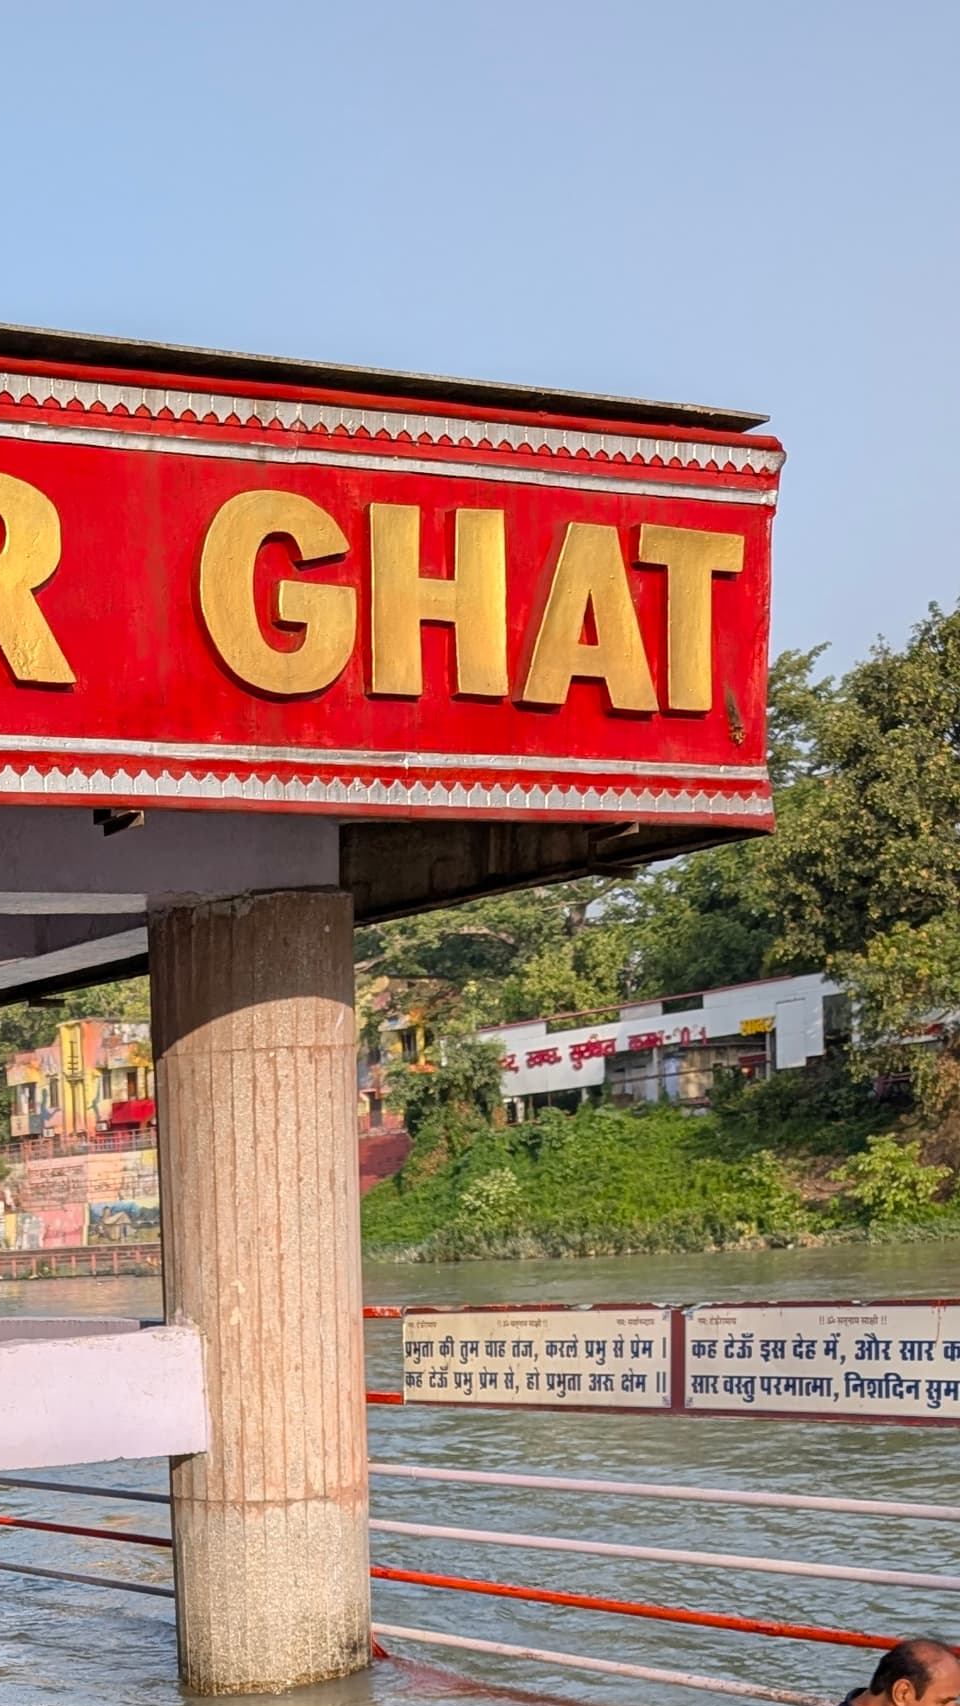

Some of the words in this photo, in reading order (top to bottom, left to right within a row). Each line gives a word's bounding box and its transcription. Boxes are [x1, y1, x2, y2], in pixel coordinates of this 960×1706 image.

[200, 490, 744, 714] GHAT
[405, 1341, 434, 1364] प्रभुता
[439, 1336, 455, 1357] की
[460, 1341, 479, 1364] तुम
[485, 1341, 506, 1357] चाह
[512, 1341, 538, 1361] तज,
[545, 1334, 578, 1358] करले
[585, 1340, 607, 1365] प्रभु
[613, 1334, 624, 1358] से
[631, 1334, 654, 1359] प्रेम
[691, 1340, 718, 1358] कह
[759, 1340, 786, 1362] इस
[792, 1333, 817, 1359] देह
[823, 1332, 846, 1365] में,
[855, 1332, 892, 1361] और
[899, 1340, 936, 1361] सार
[405, 1371, 424, 1388] कह
[454, 1372, 474, 1395] प्रभु
[479, 1367, 498, 1389] प्रेम
[504, 1367, 519, 1394] से,
[526, 1368, 540, 1390] हो
[546, 1373, 582, 1397] प्रभुता
[621, 1368, 647, 1392] क्षेम
[691, 1375, 719, 1394] सार
[722, 1376, 757, 1402] वस्तु
[759, 1376, 839, 1402] परमात्मा,
[845, 1372, 921, 1400] निशदिन
